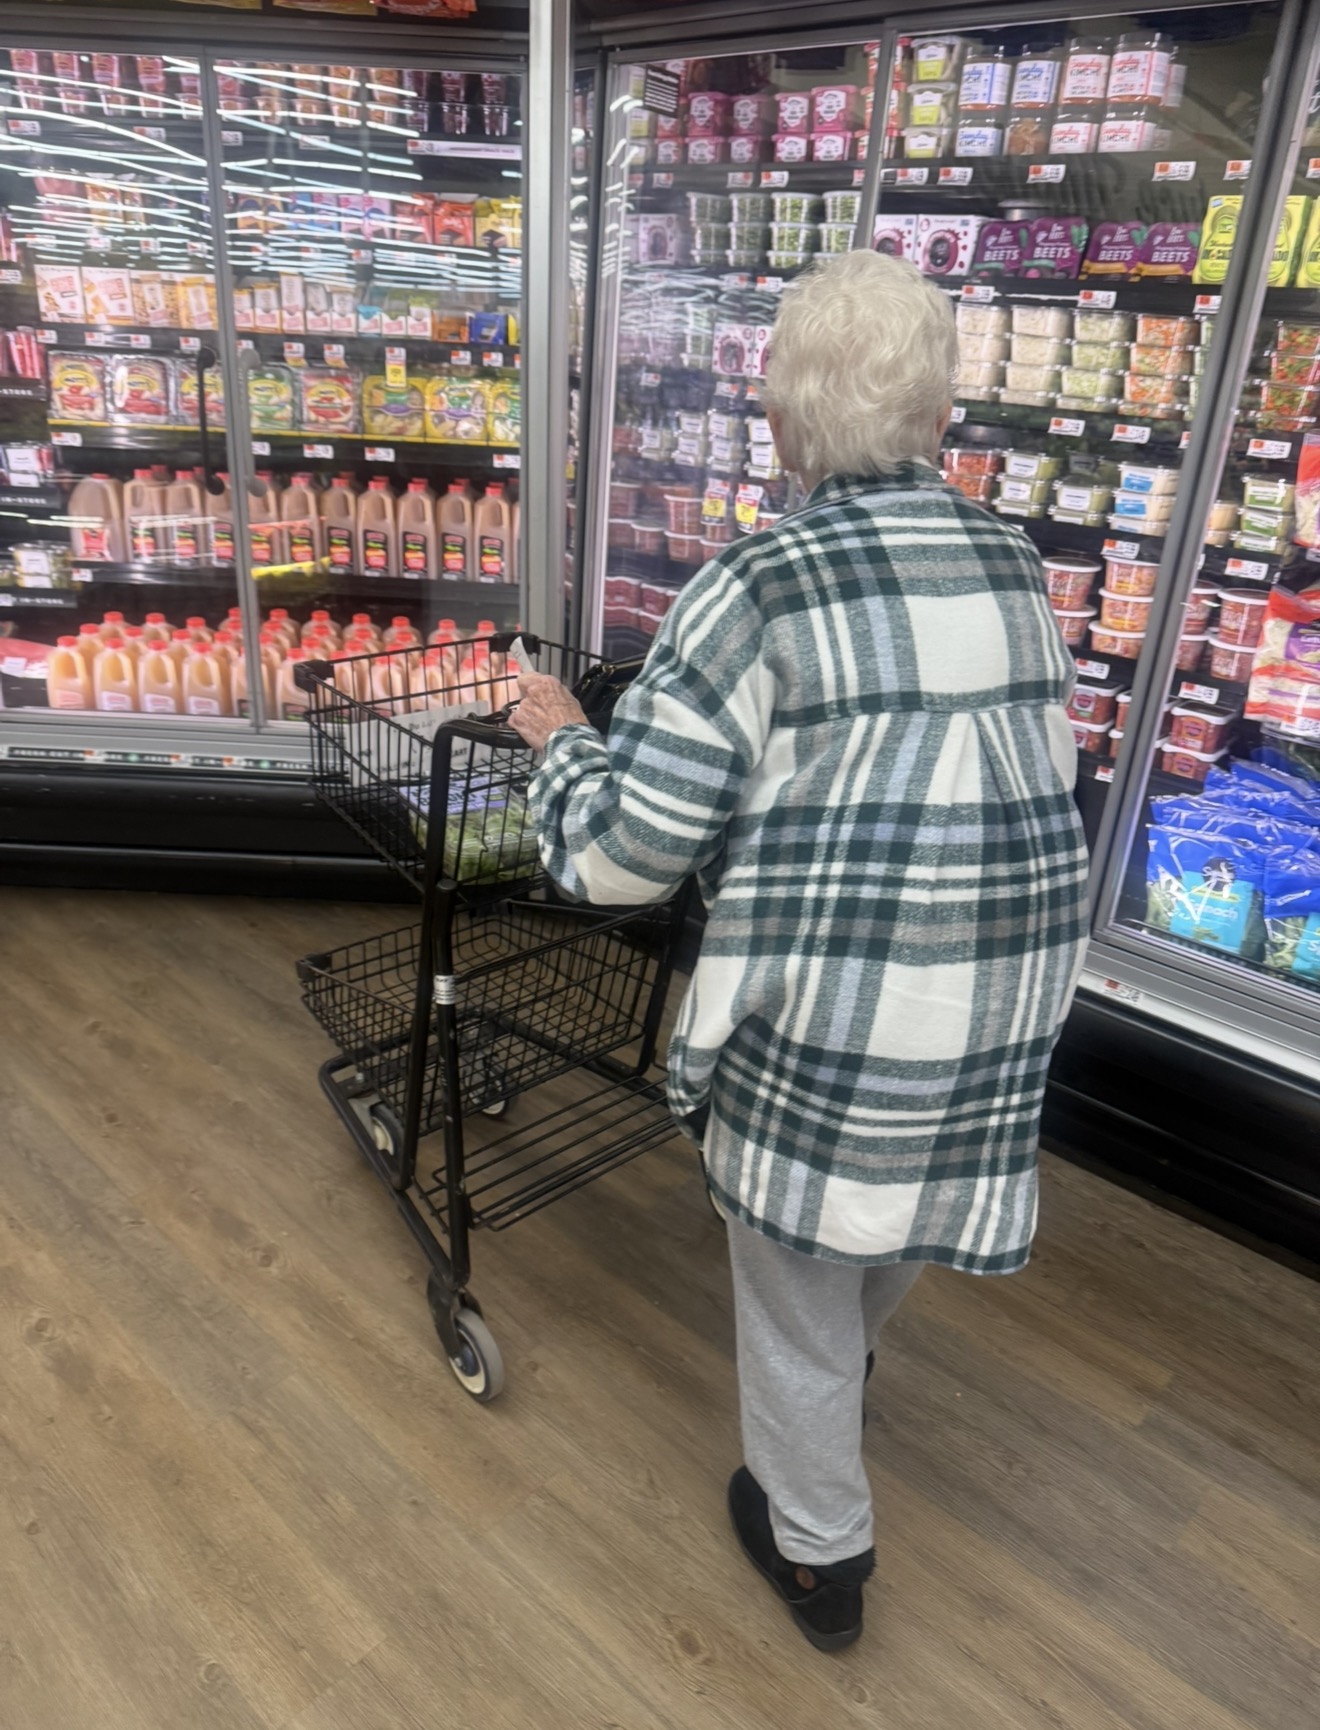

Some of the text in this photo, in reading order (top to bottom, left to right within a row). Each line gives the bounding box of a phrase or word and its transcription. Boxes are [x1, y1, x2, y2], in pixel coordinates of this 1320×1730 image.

[984, 249, 1020, 262] BEETS
[1033, 247, 1071, 259] BEETS
[1098, 249, 1133, 262] BEETS
[1151, 251, 1190, 263] BEETS
